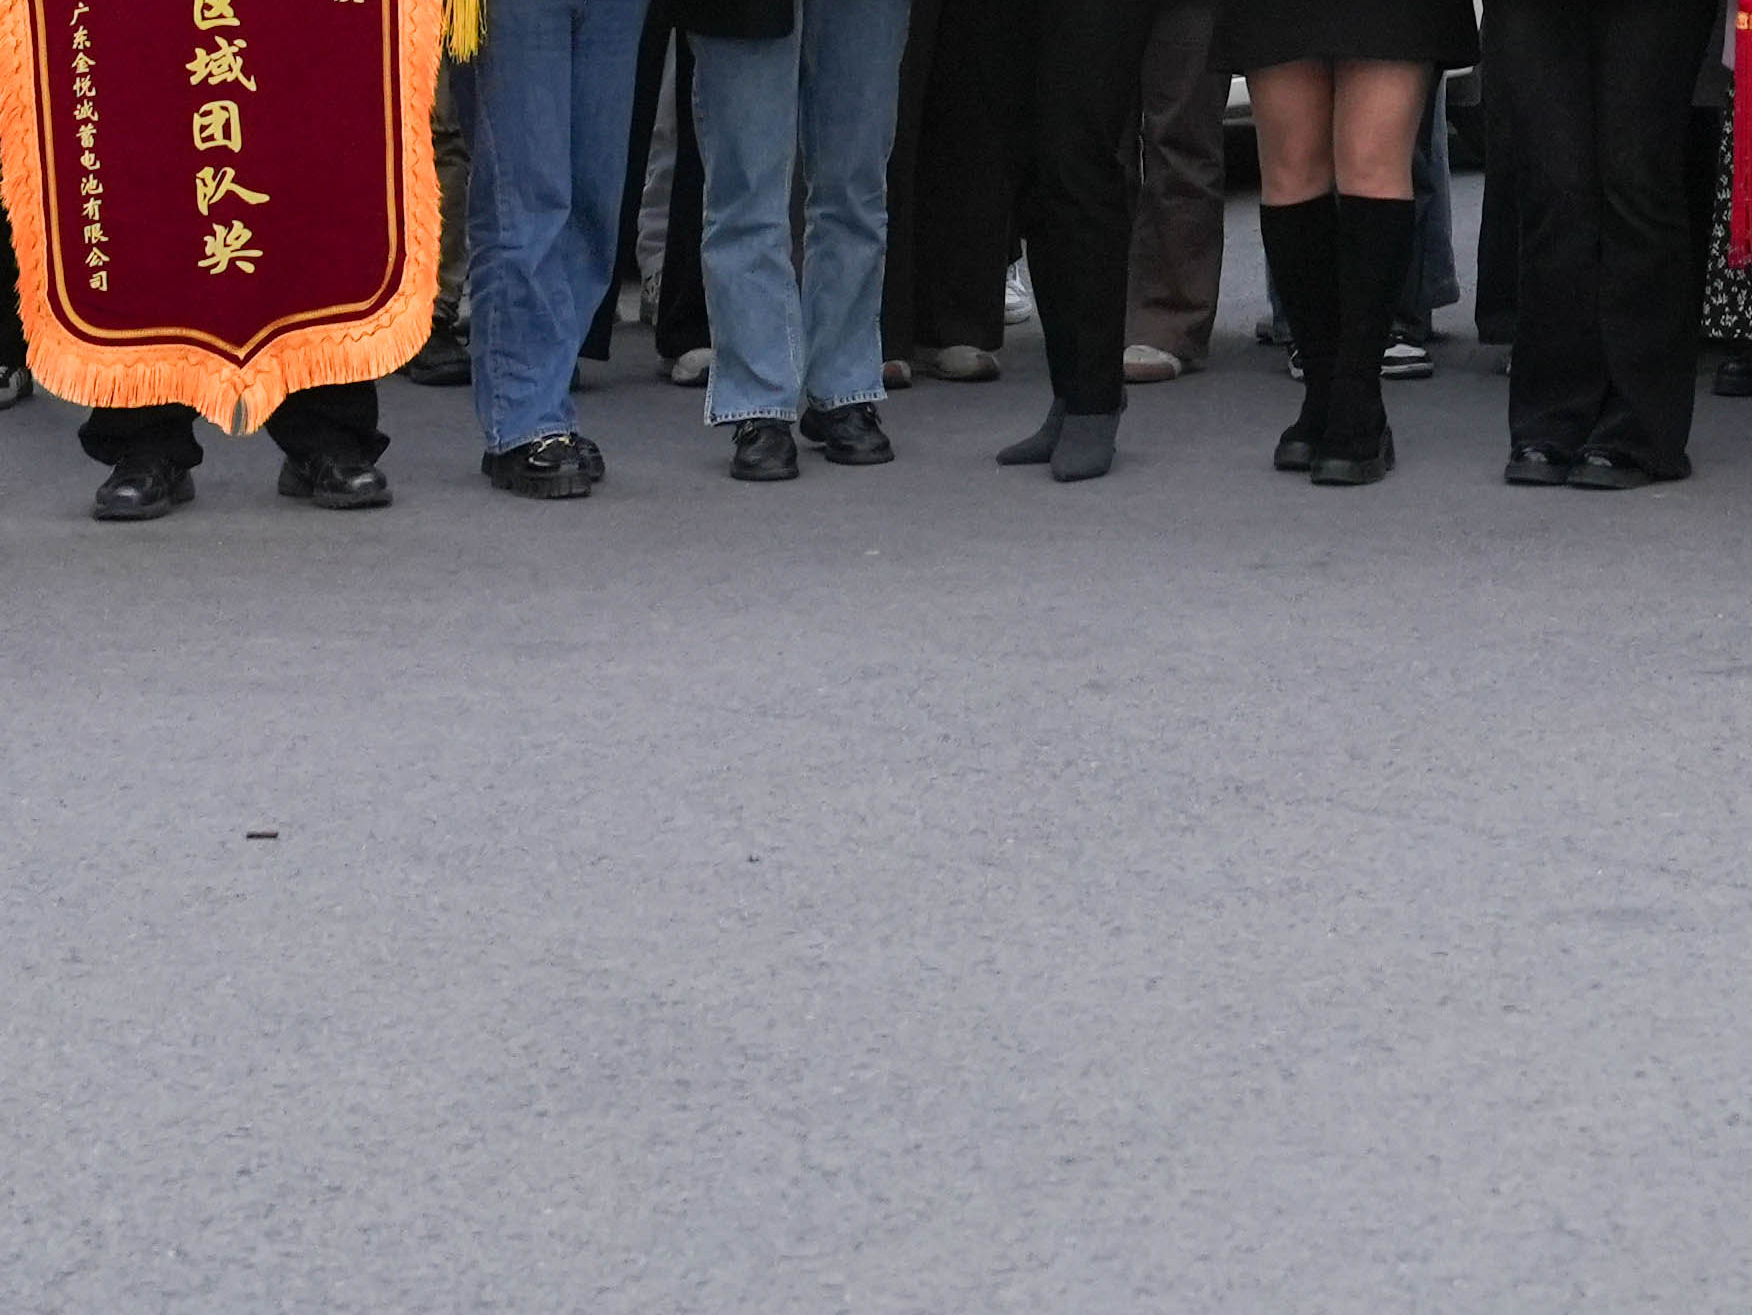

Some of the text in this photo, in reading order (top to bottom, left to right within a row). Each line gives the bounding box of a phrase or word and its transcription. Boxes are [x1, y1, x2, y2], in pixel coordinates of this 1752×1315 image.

[69, 1, 111, 292] 广东金悦诚蓄电池有限公司
